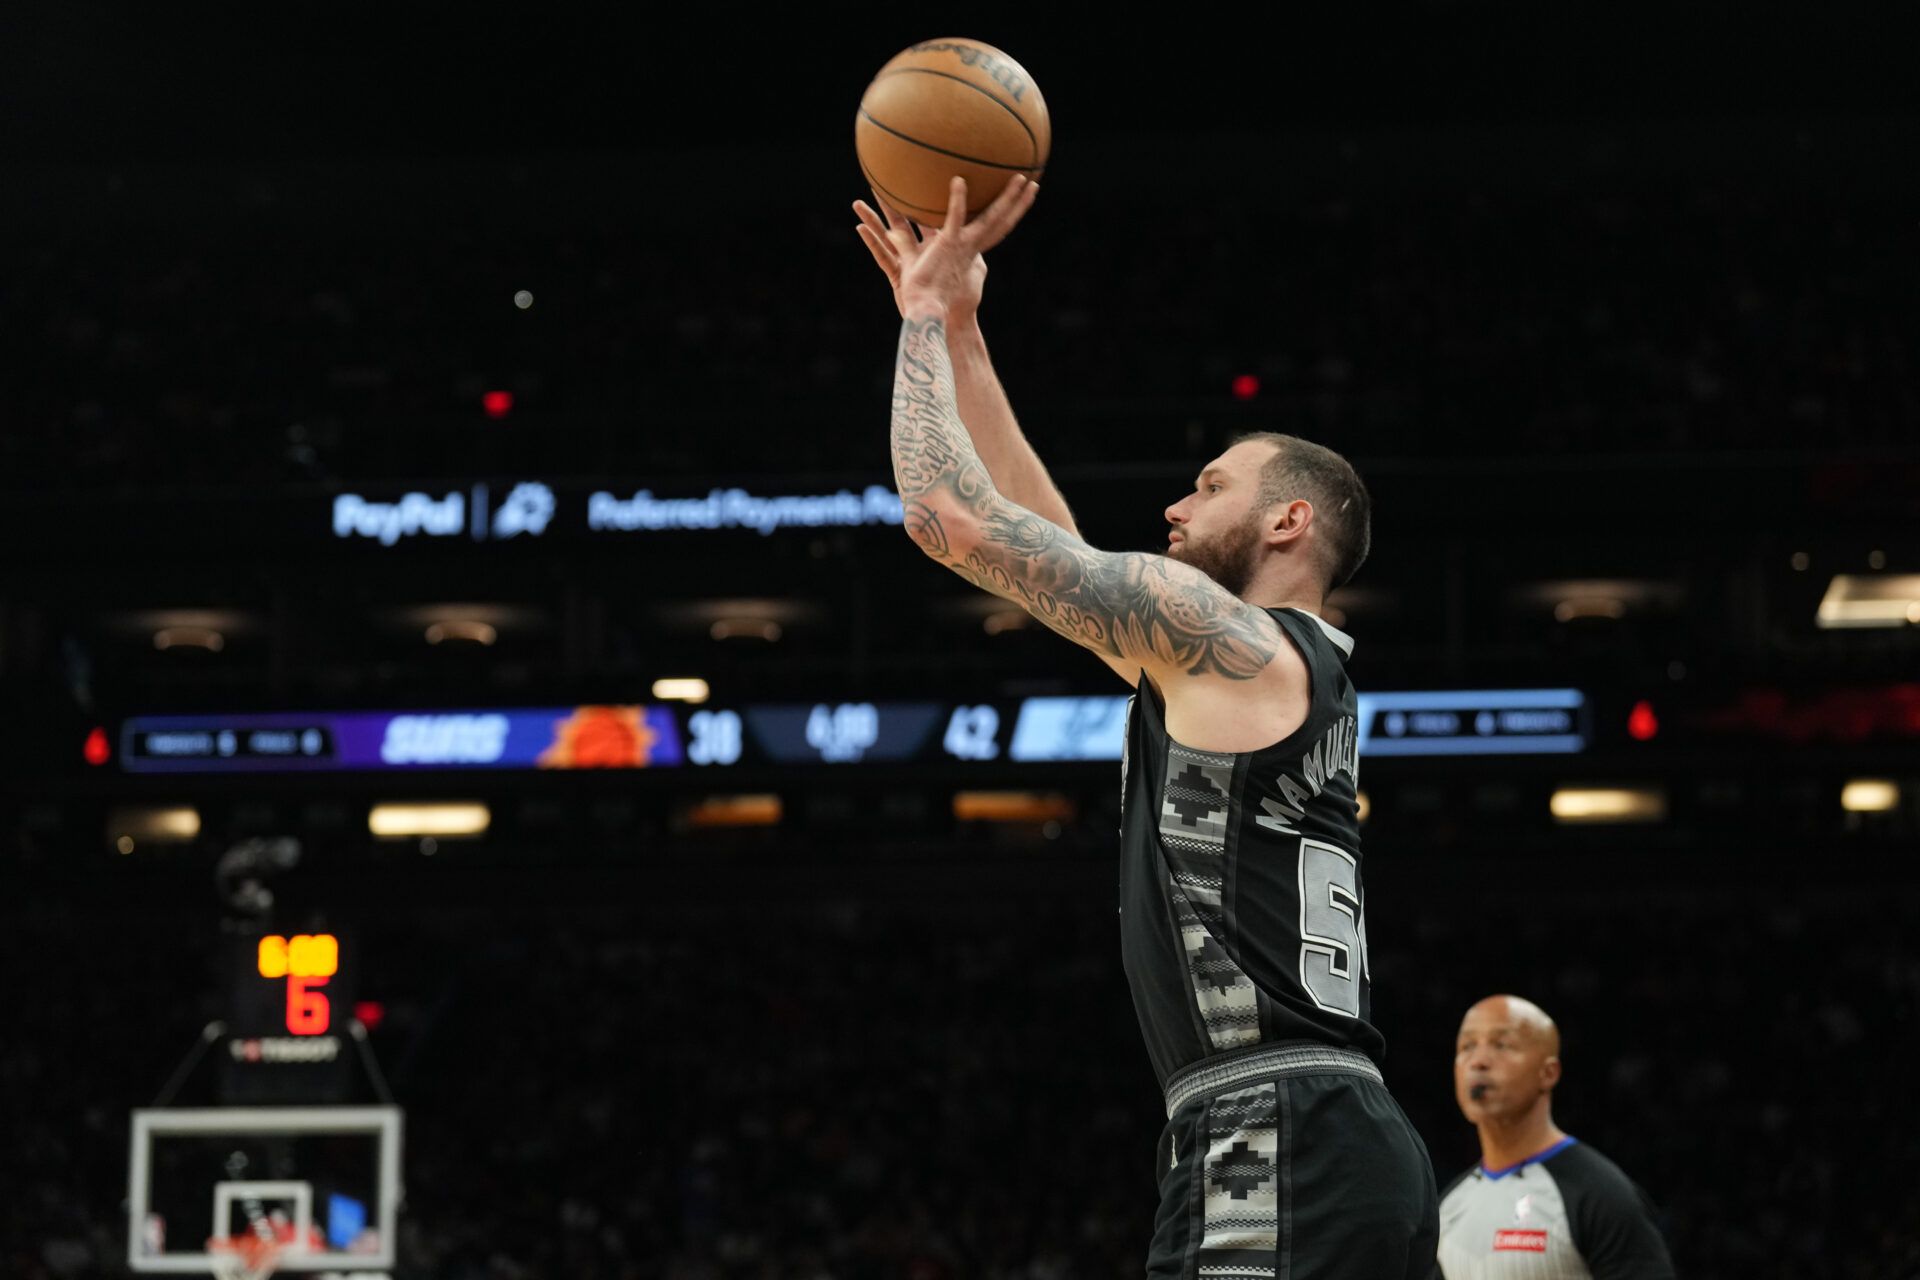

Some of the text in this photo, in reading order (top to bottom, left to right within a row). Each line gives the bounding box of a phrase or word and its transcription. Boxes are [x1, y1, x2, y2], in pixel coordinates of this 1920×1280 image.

[333, 491, 464, 546] PayPal
[589, 490, 721, 530] Preferred
[721, 488, 861, 536] Payments
[942, 704, 1000, 761] 42
[1298, 838, 1370, 1018] 5
[286, 973, 330, 1035] 6
